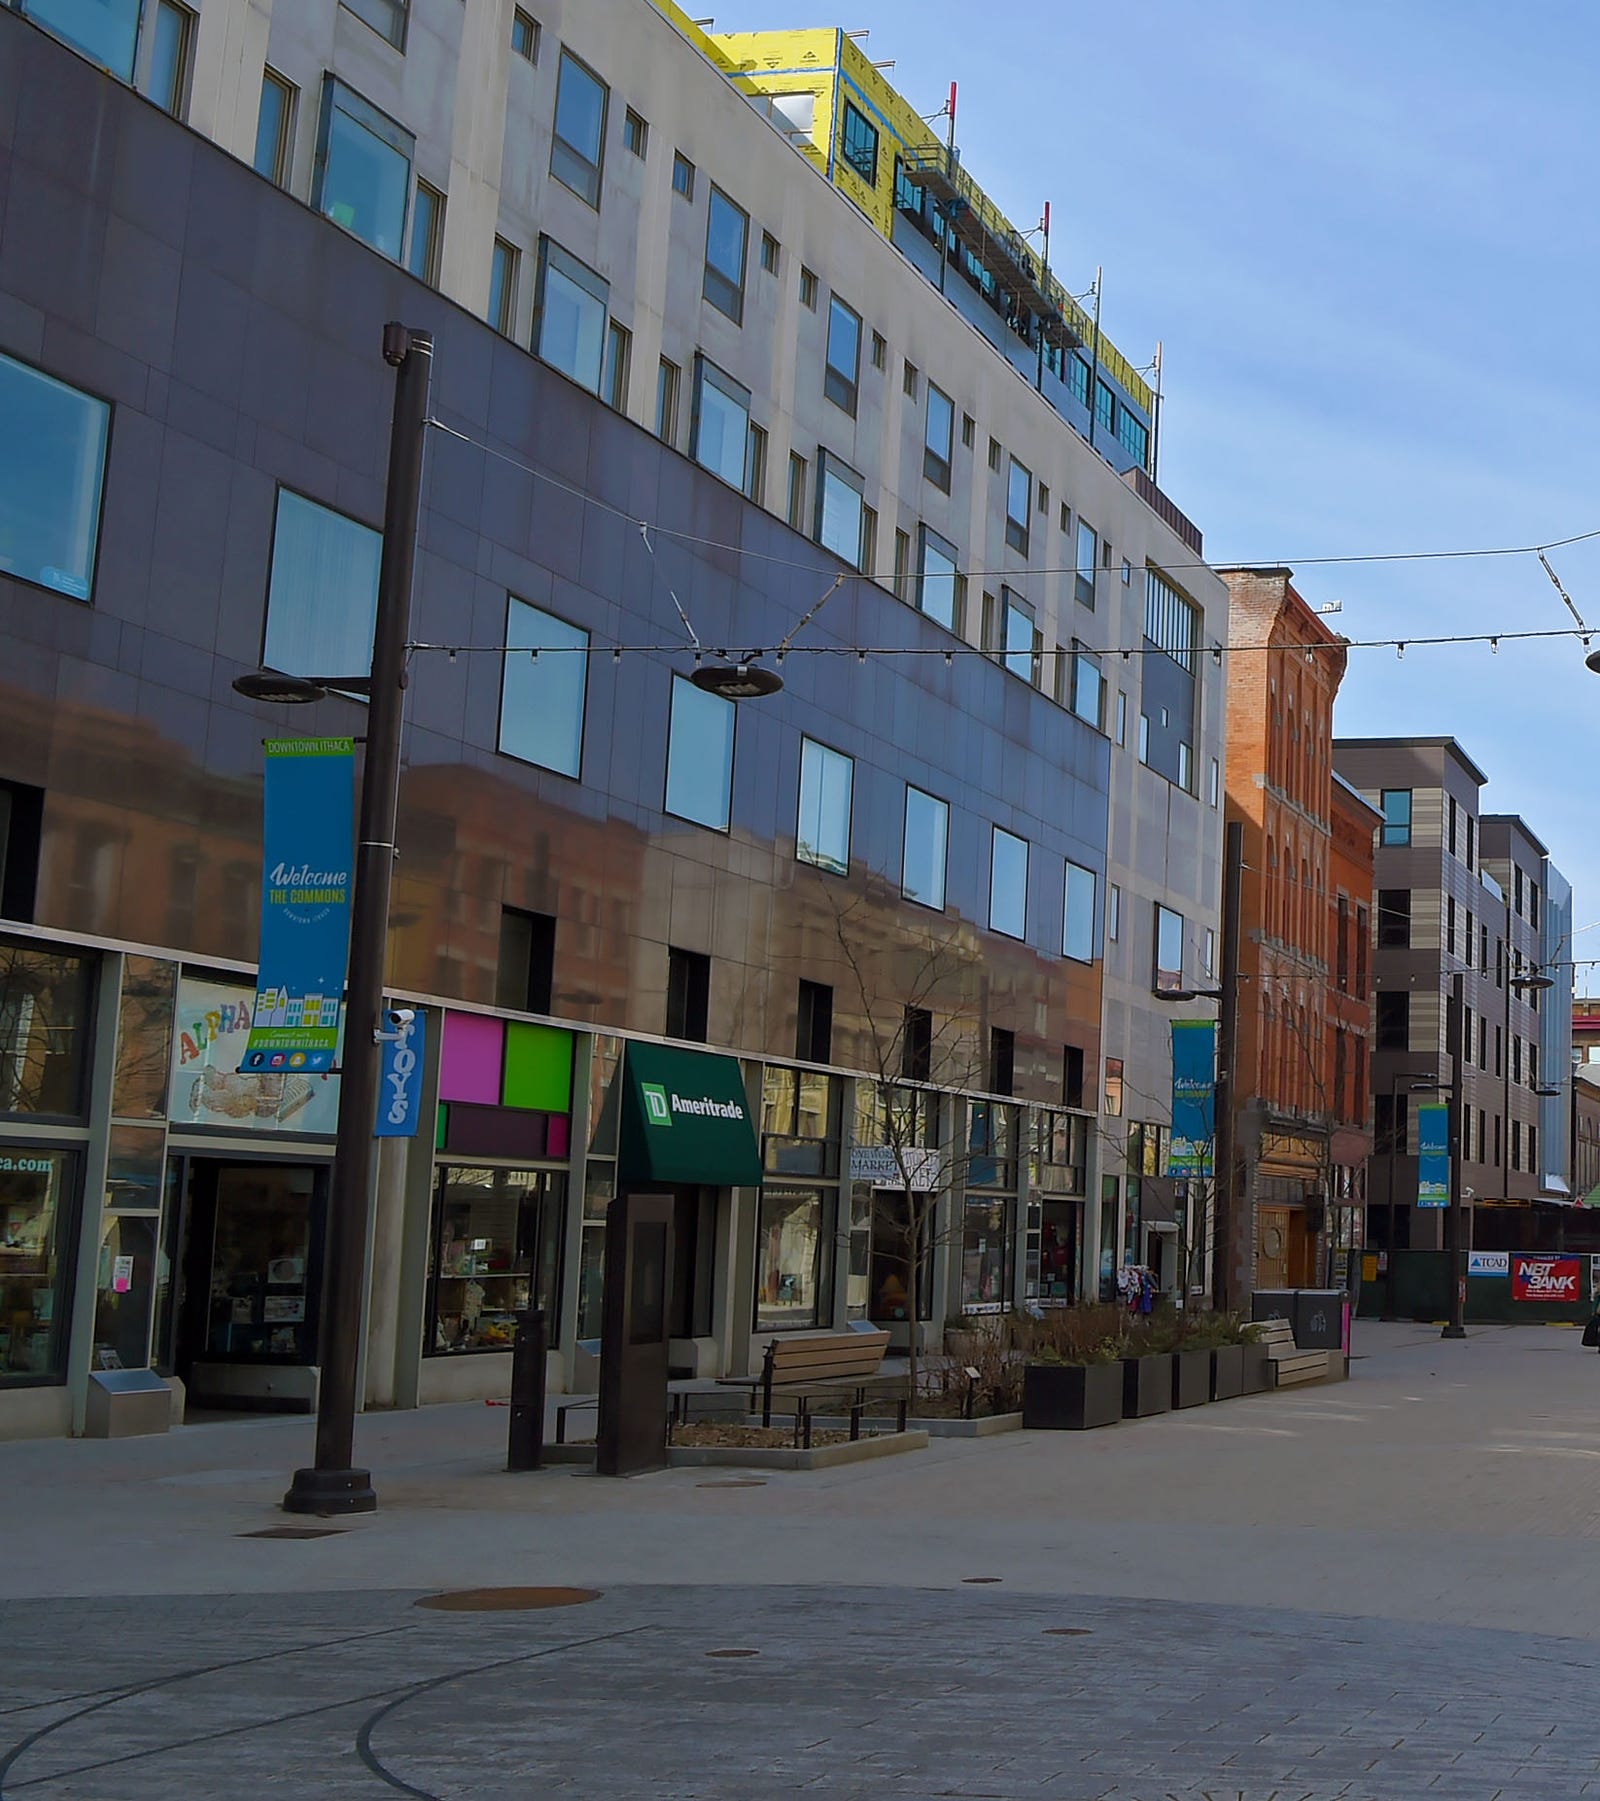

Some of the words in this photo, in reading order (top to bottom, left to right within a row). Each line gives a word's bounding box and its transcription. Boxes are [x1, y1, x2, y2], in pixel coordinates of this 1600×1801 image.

[268, 742, 318, 753] DOWNTOWN
[319, 741, 350, 752] ITHACA
[270, 862, 348, 887] Welcome
[270, 889, 287, 904] THE
[290, 888, 346, 904] COMMONS
[180, 1000, 251, 1065] ALPHA
[387, 1023, 416, 1125] TOYS
[645, 1091, 666, 1118] TD
[671, 1093, 744, 1120] Ameritrade
[851, 1159, 898, 1172] MARKET
[1519, 1262, 1555, 1276] NBT
[1528, 1276, 1576, 1290] BANK
